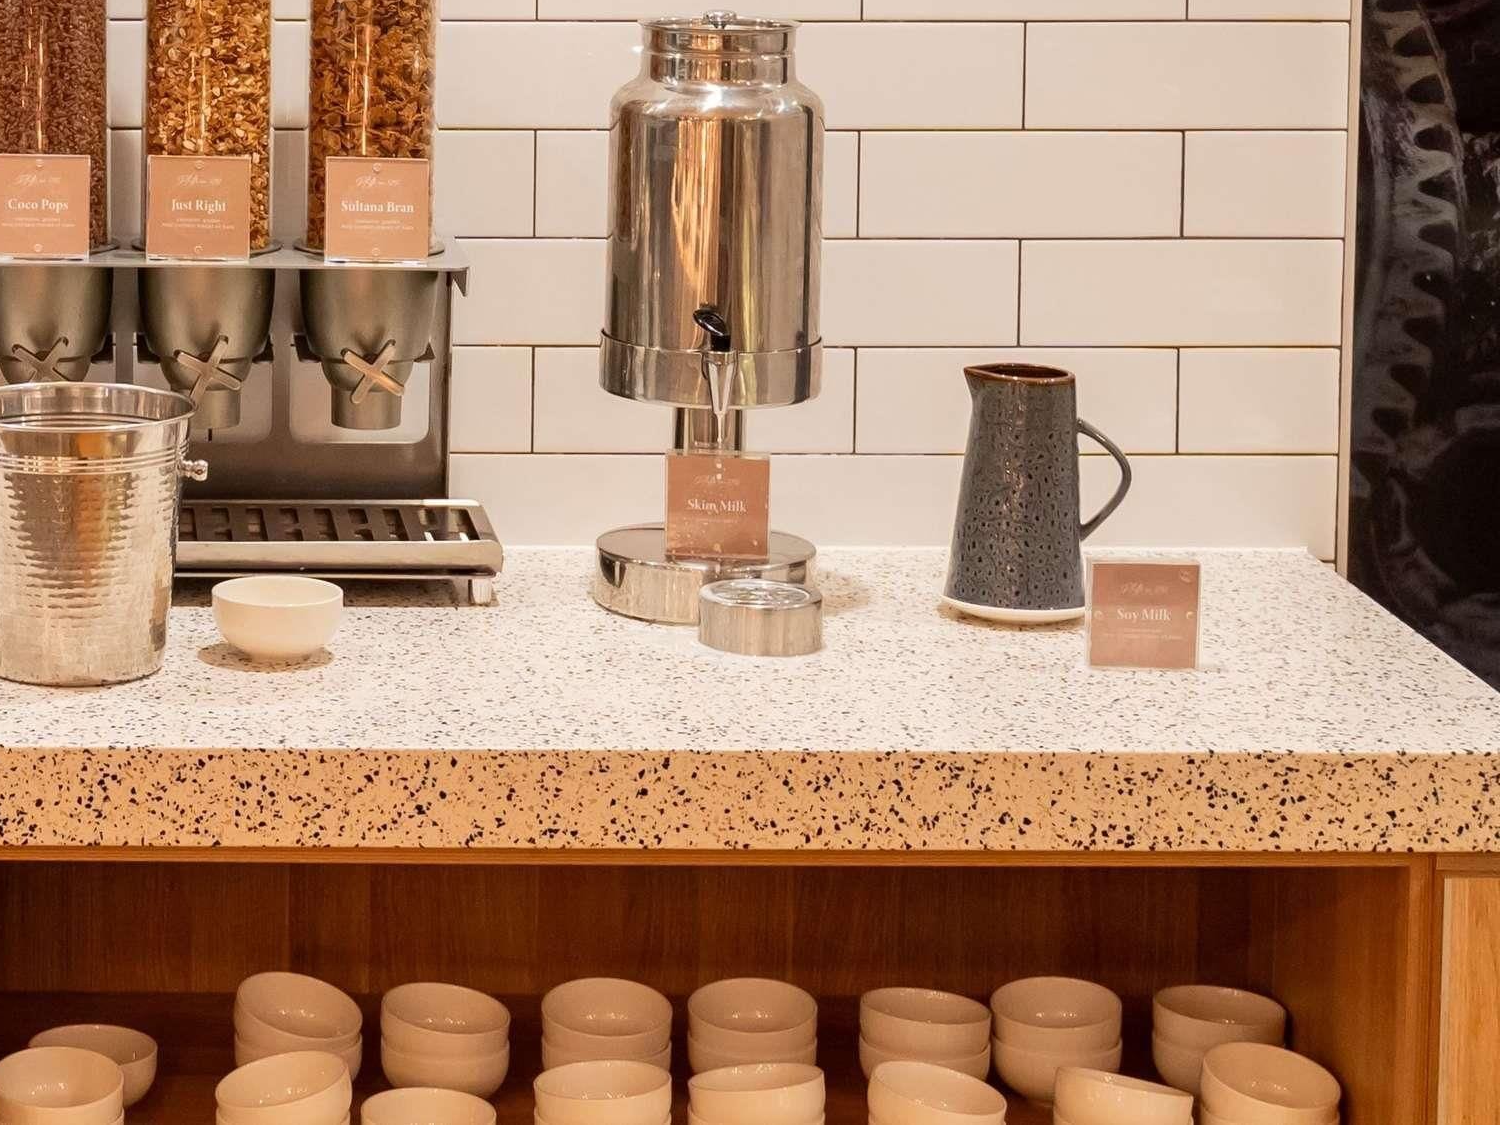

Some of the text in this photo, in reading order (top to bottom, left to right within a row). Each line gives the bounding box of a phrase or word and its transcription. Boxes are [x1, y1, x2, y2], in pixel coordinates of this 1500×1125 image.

[7, 198, 69, 214] Coco Pops
[171, 199, 226, 215] Just Right
[340, 200, 414, 213] Sultana Bran
[687, 498, 747, 512] Skim Milk
[1116, 608, 1172, 623] Soy Milk
